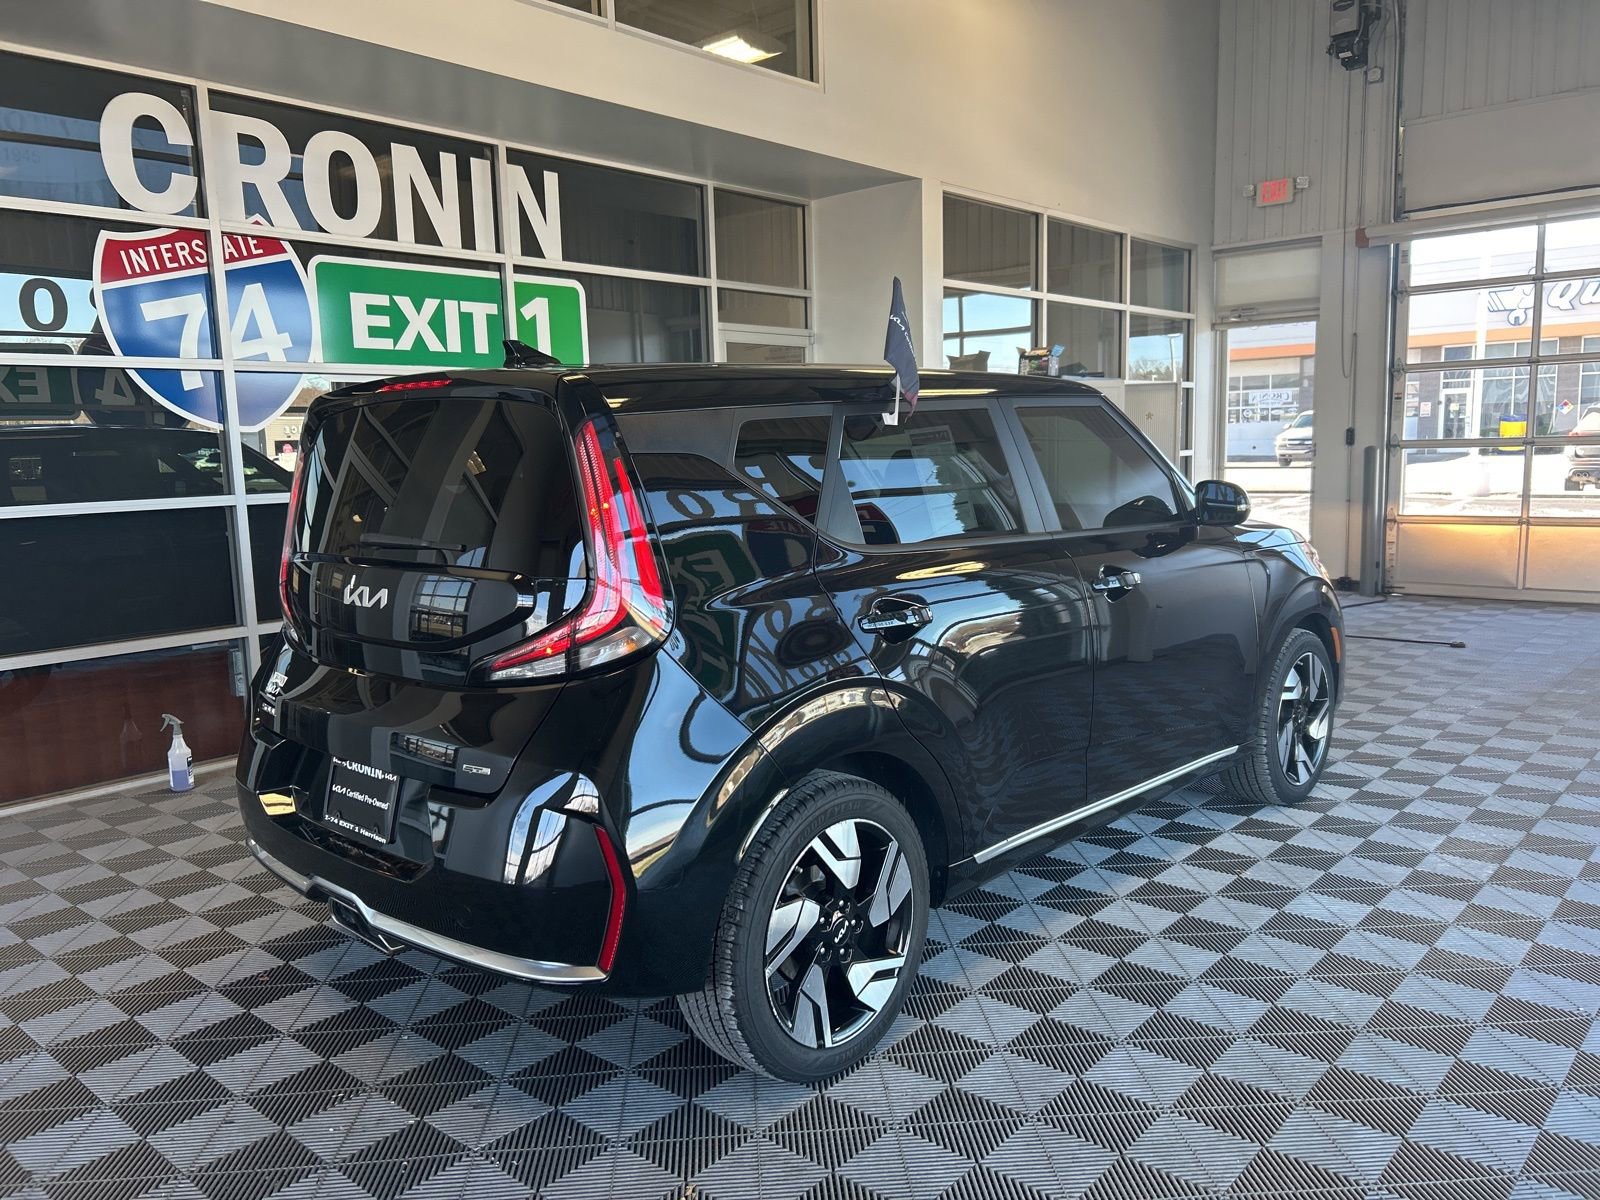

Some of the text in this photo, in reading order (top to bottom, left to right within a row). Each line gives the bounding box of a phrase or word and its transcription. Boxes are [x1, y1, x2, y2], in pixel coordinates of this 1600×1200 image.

[100, 92, 562, 260] CRONIN
[119, 234, 264, 275] INTERSATE
[139, 283, 294, 391] 74
[349, 292, 552, 356] EXIT 1
[343, 574, 388, 610] KIA
[346, 788, 365, 802] Certified
[364, 794, 389, 810] Pre-Owned
[338, 820, 354, 830] EXIT
[359, 828, 387, 844] Harrison
